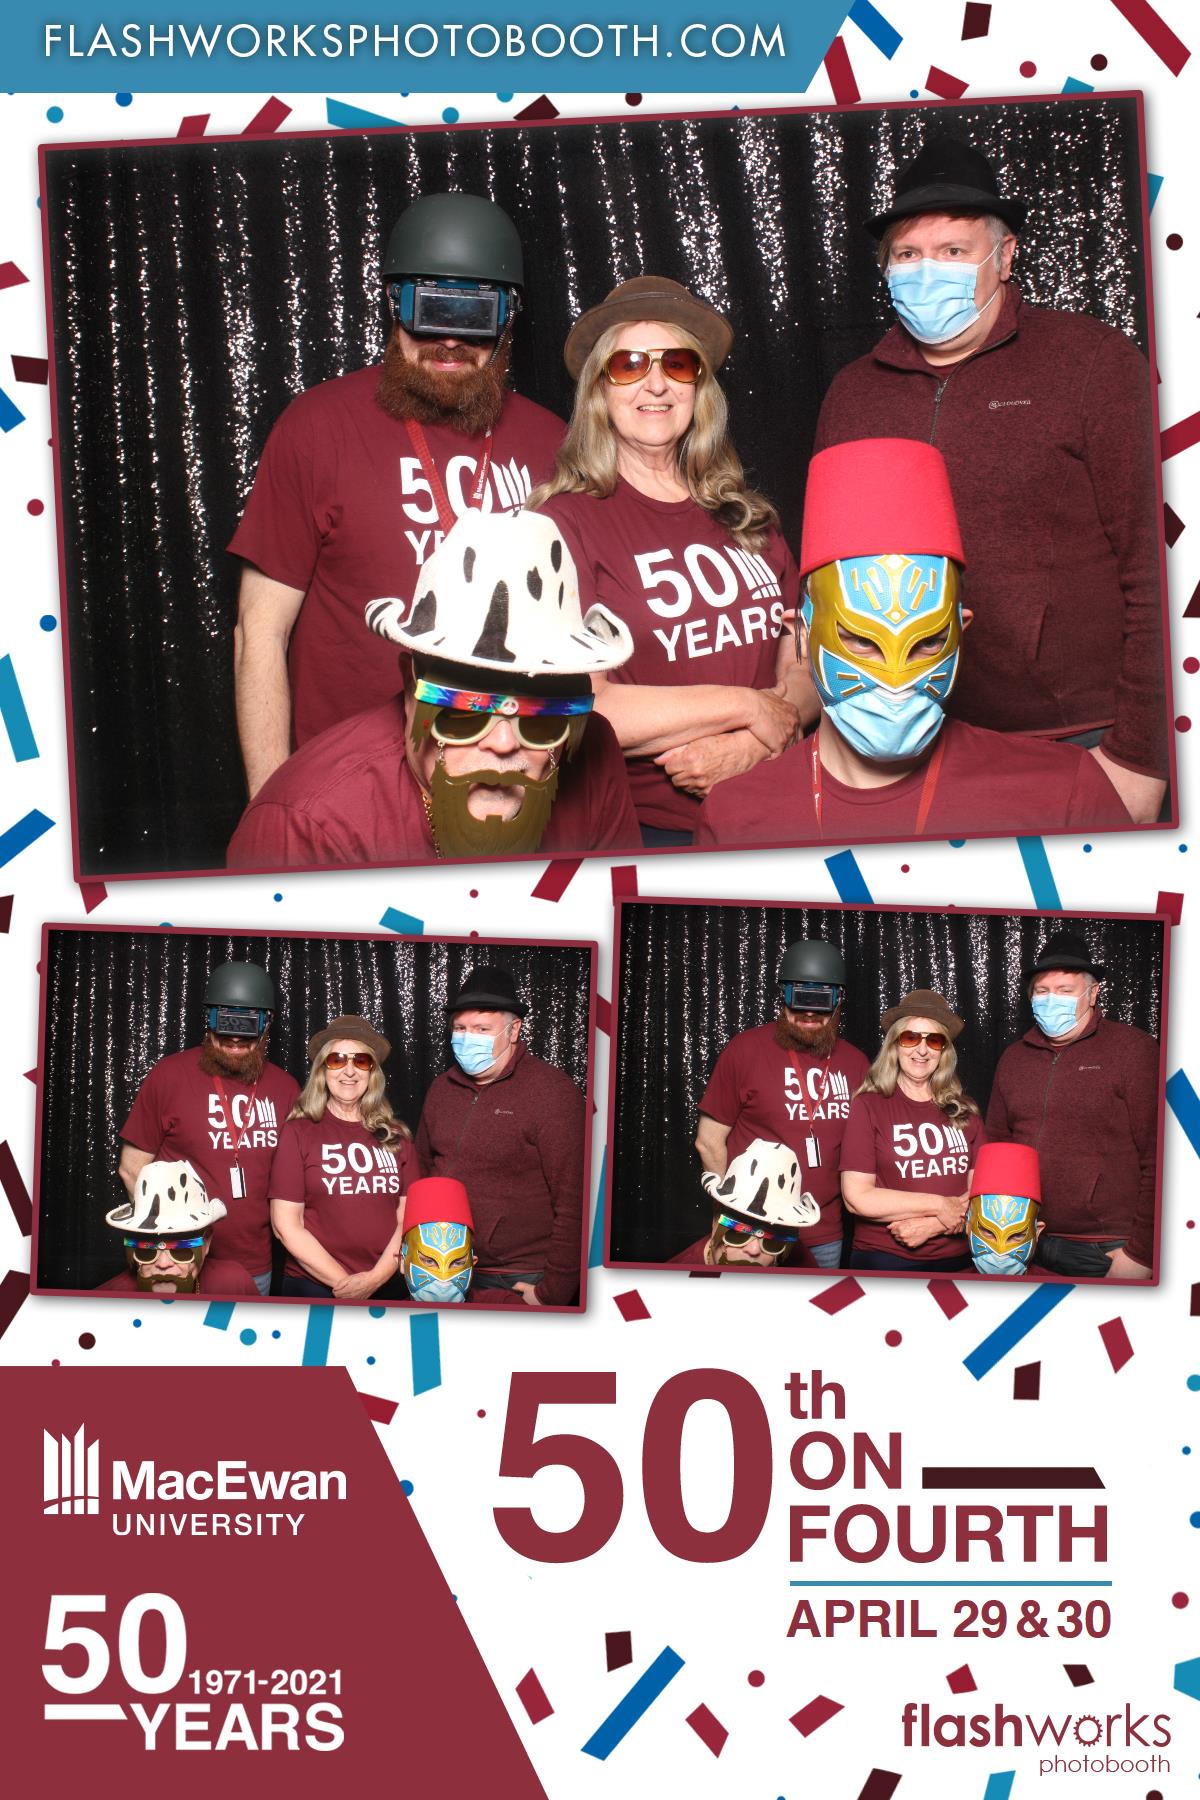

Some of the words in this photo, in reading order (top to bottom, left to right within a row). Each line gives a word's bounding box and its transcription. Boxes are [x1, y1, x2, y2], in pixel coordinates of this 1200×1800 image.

[400, 455, 494, 525] 50
[634, 543, 738, 619] 50
[652, 601, 784, 662] YEARS
[783, 1067, 832, 1101] 50
[207, 1093, 256, 1129] 50
[785, 1101, 850, 1121] YEARS
[208, 1129, 278, 1150] YEARS
[892, 1122, 945, 1159] 50
[321, 1142, 376, 1175] 50
[893, 1157, 969, 1179] YEARS
[321, 1175, 401, 1196] YEARS
